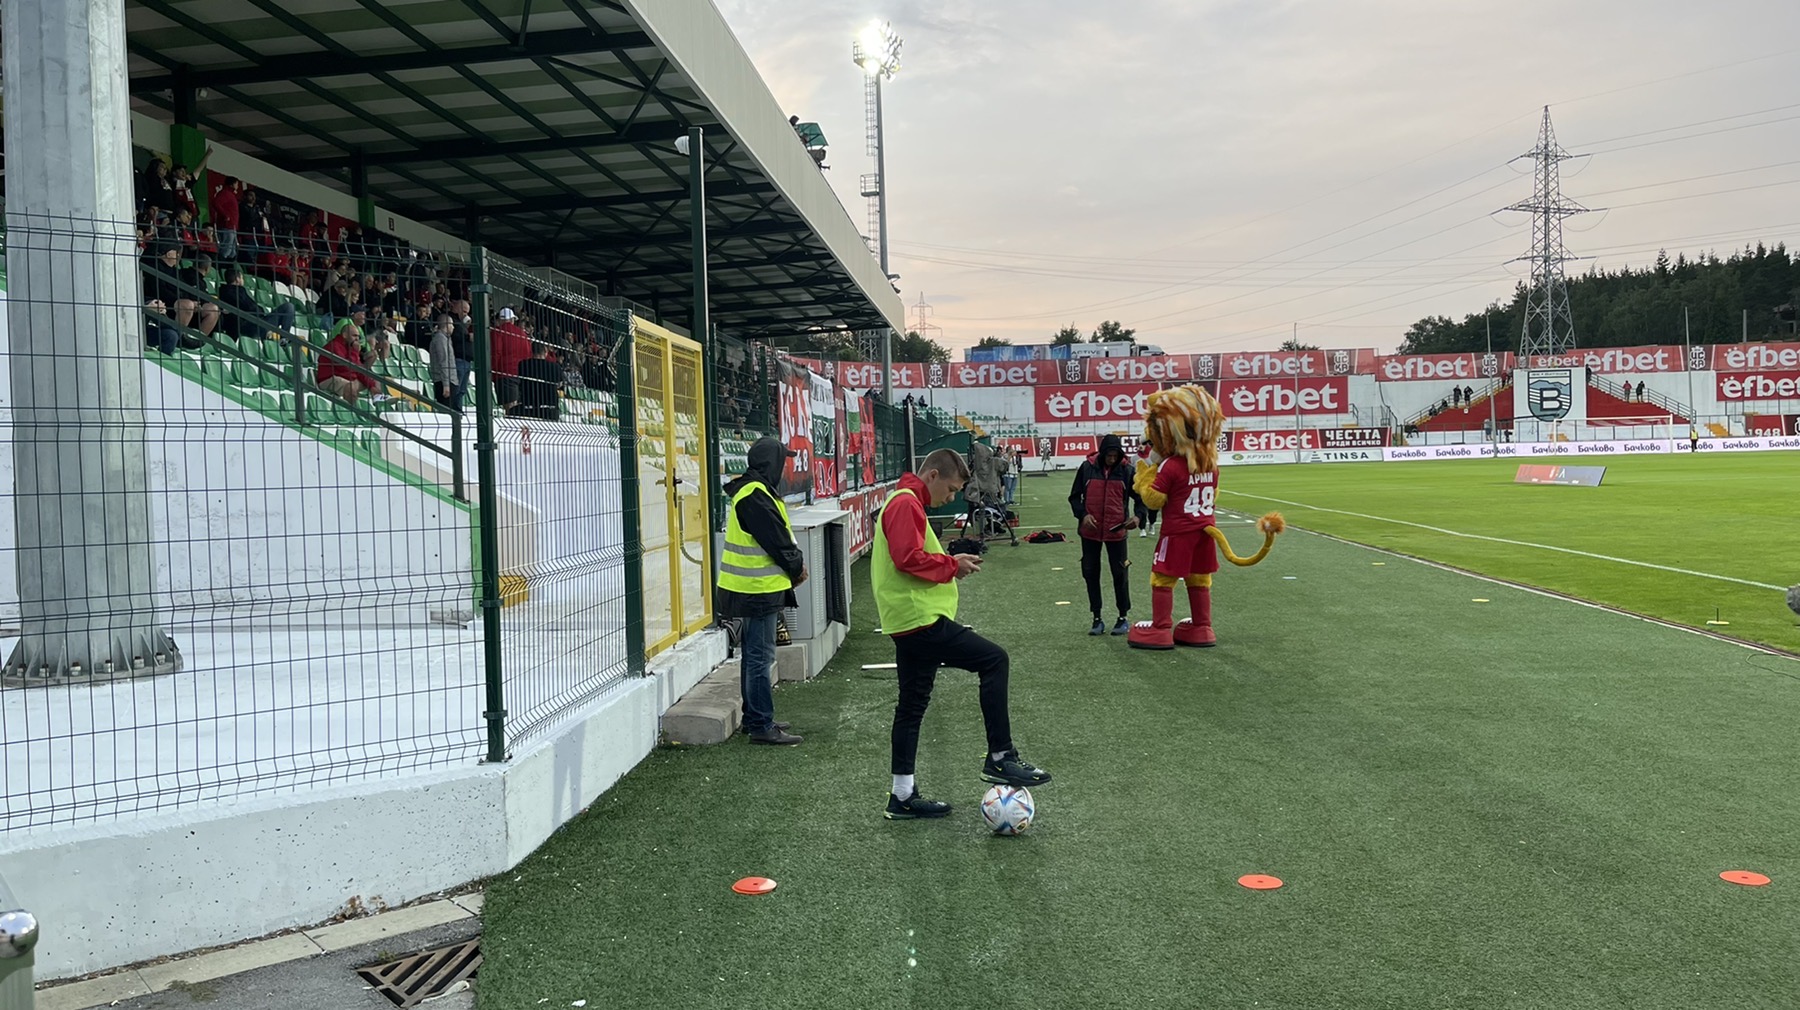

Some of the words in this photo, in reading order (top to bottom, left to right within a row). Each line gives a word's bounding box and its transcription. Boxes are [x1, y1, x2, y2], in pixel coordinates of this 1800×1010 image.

[1232, 353, 1314, 376] efbet
[1384, 357, 1467, 379] efbet
[1584, 349, 1668, 373] efbet
[1726, 346, 1800, 368] efbe
[959, 363, 1038, 386] efbet
[1099, 359, 1179, 380] efbet
[1049, 389, 1149, 417] efbet
[1232, 383, 1338, 412] efbet
[1243, 432, 1312, 450] efbet
[1325, 429, 1381, 440] ЧЕСТТА
[1063, 442, 1090, 451] 1948
[1324, 452, 1369, 460] TINSA
[1391, 450, 1427, 458] Бачково
[1435, 449, 1471, 457] Бачково
[1578, 445, 1614, 453] Бачково
[1624, 443, 1661, 452] Бачково
[1722, 441, 1759, 449] Бачково
[1768, 439, 1800, 448] Бачков
[1188, 472, 1213, 486] АРМИ
[1184, 486, 1215, 517] 48
